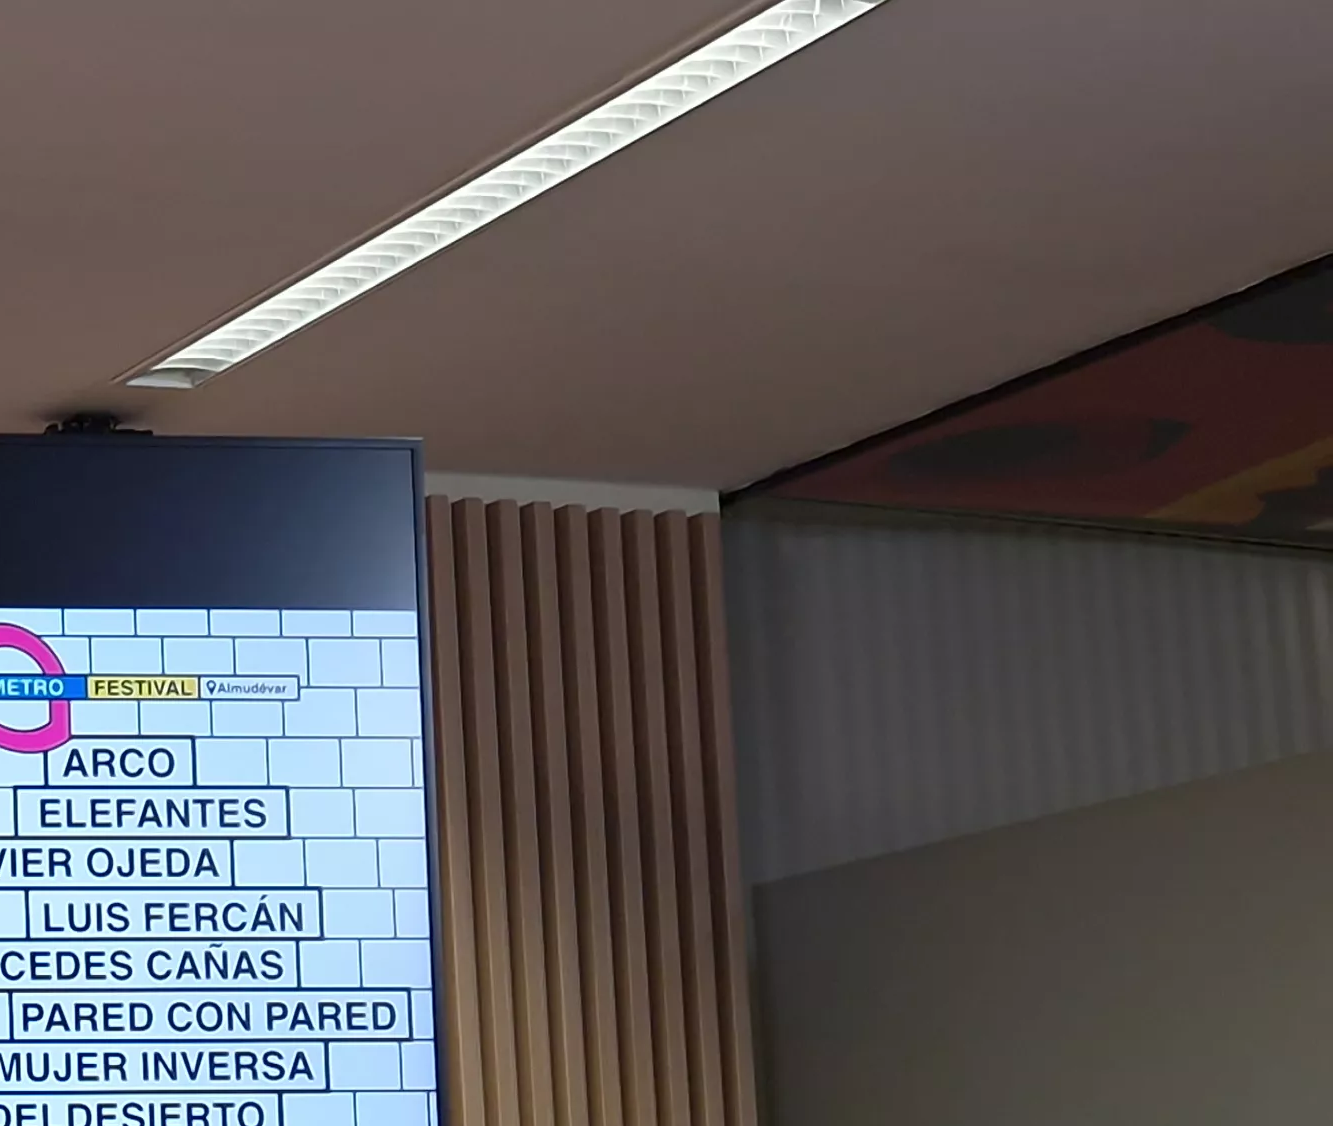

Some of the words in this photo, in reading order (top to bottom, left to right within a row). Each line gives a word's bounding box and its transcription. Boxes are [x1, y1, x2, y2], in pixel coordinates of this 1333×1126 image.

[94, 679, 196, 697] FESTIVAL
[217, 682, 288, 695] Almudévar
[63, 748, 176, 778] ARCO
[39, 798, 267, 829] ELEFANTES
[86, 847, 220, 879] OJEDA
[42, 902, 130, 934] LUIS
[144, 895, 303, 932] FERCÁN
[146, 944, 284, 980] CAÑAS
[22, 1003, 154, 1033] PARED
[167, 1002, 252, 1032] CON
[266, 1001, 396, 1031] PARED
[141, 1051, 314, 1082] INVERSA
